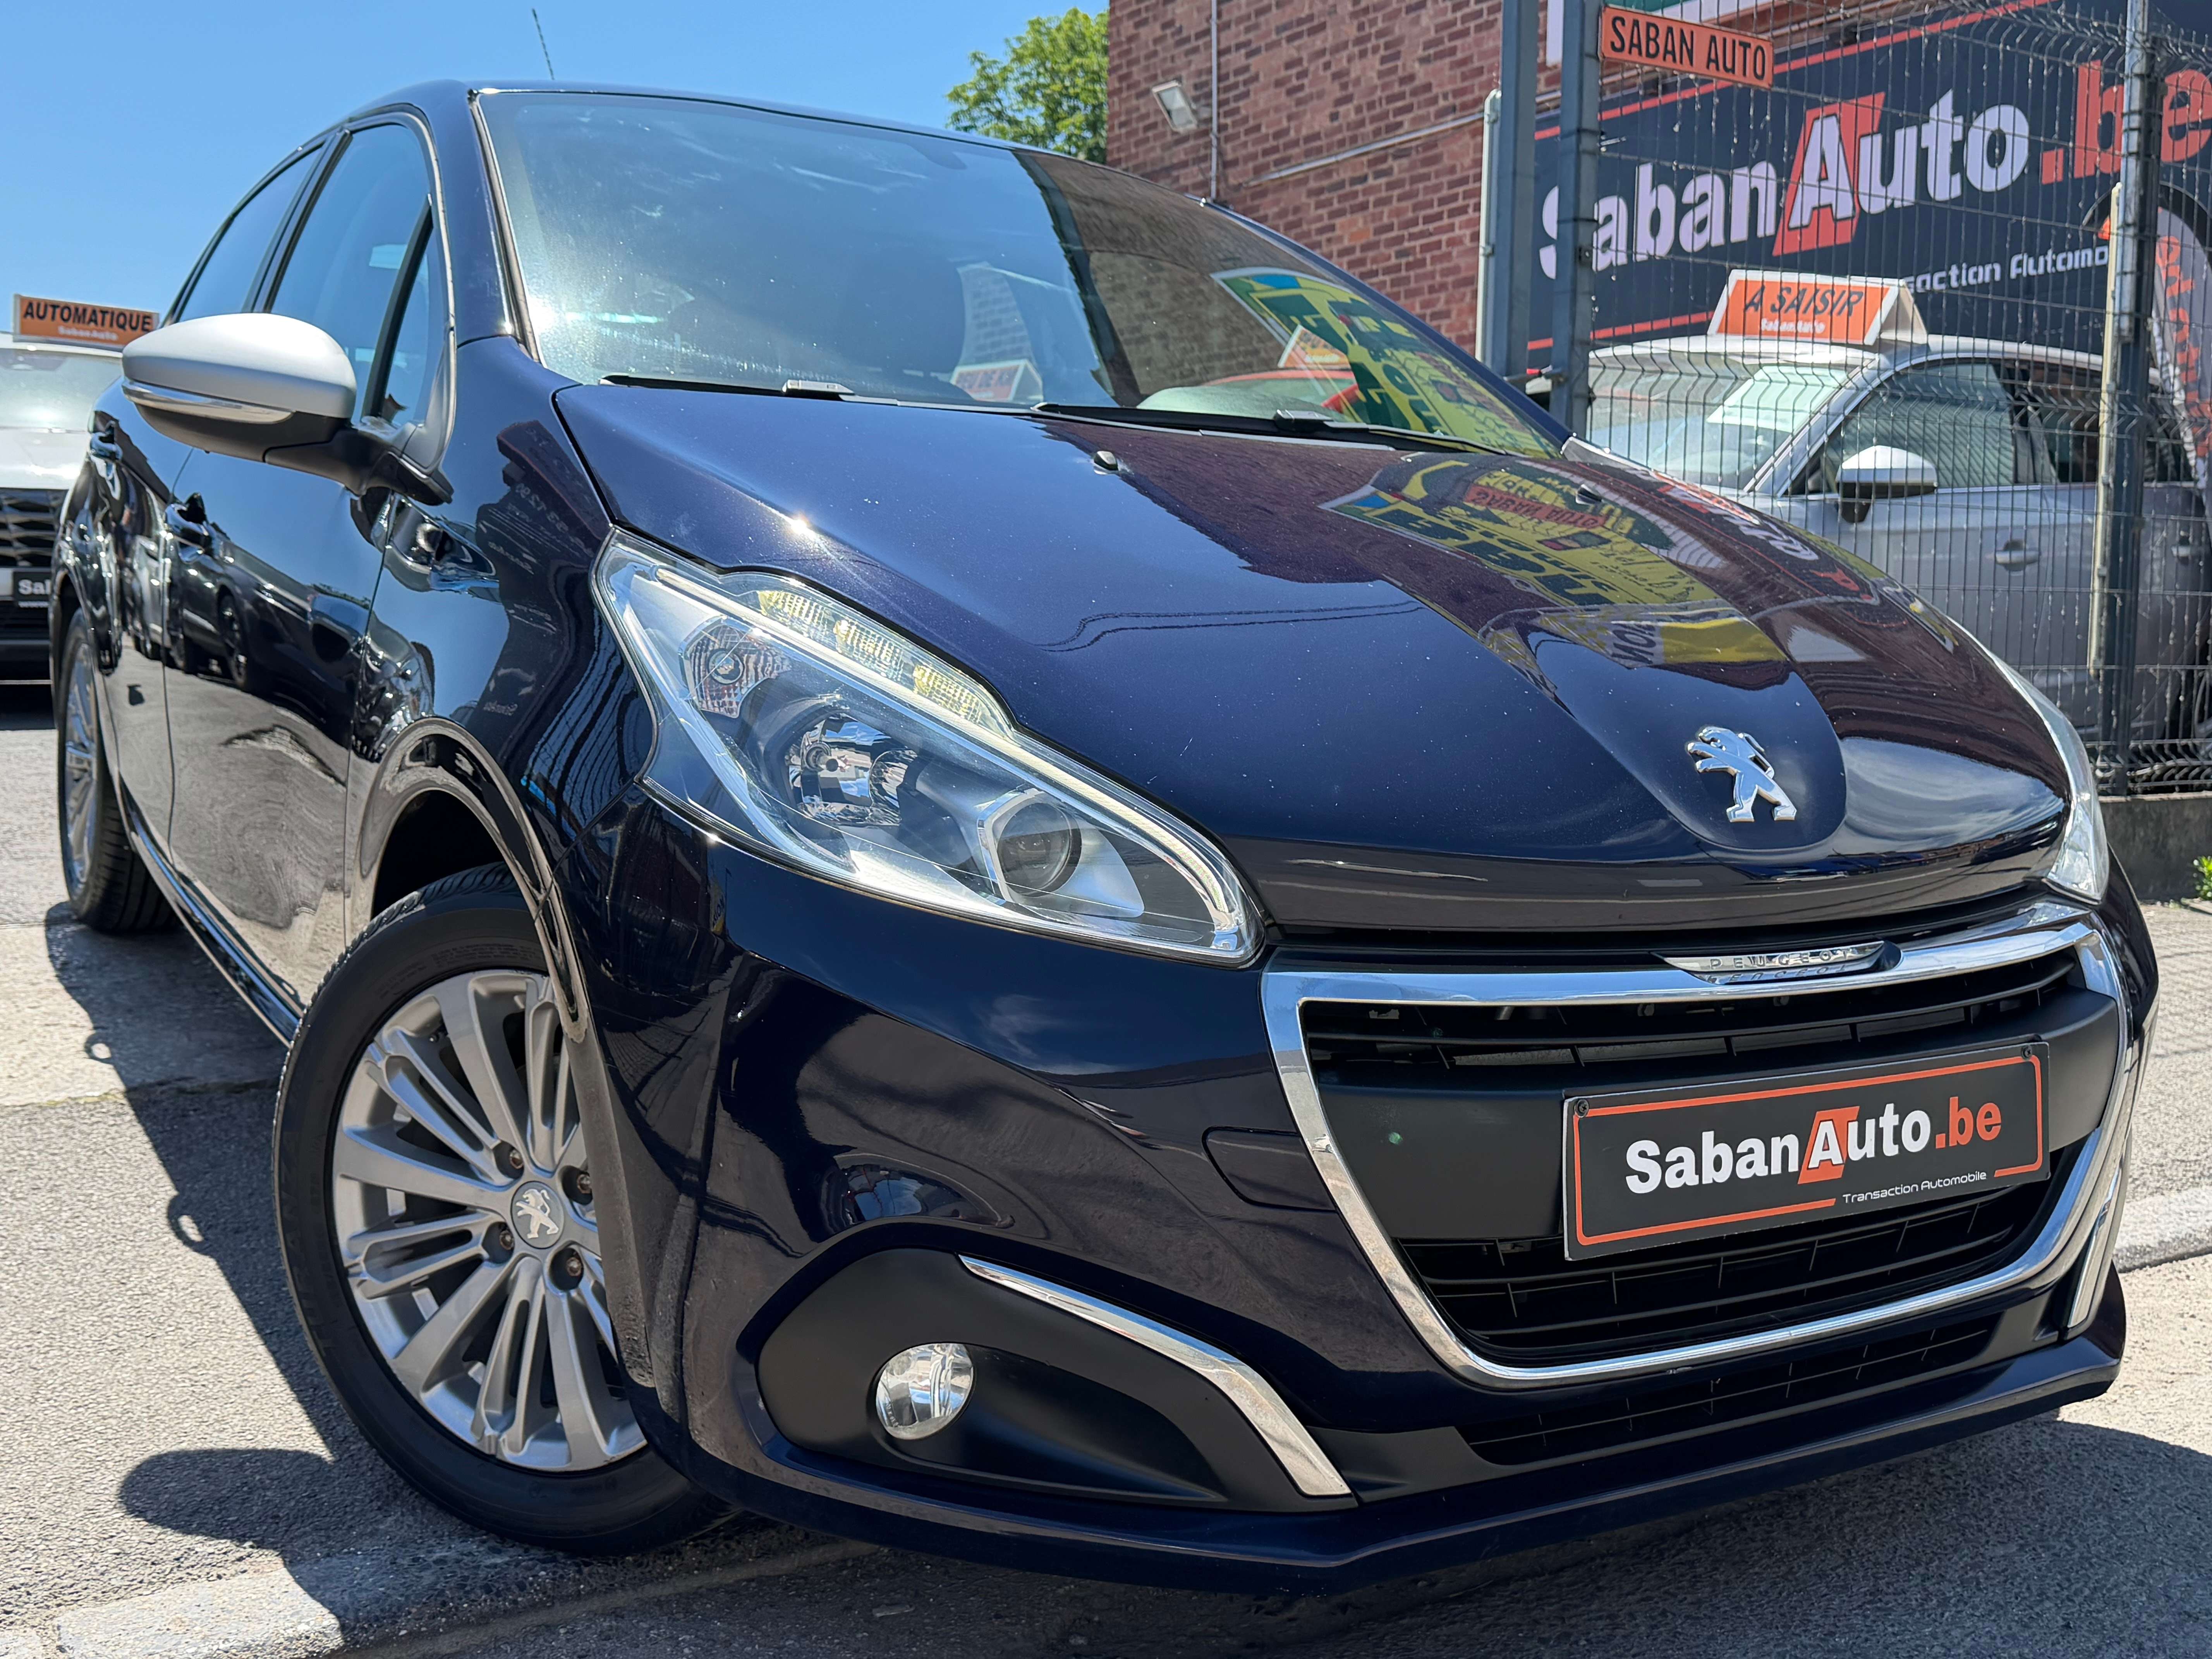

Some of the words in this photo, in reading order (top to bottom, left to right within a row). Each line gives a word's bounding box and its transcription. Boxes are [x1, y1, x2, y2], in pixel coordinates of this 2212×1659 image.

[1610, 15, 1694, 67] SABAN
[1706, 34, 1766, 81] AUTO
[2009, 245, 2109, 280] Automo
[23, 302, 153, 332] AUTOMATIQUE
[1744, 285, 1765, 313] A
[1770, 286, 1864, 317] SAISIR
[1709, 948, 1855, 970] PEUGEOT
[1626, 1096, 2002, 1194] SabanAuto.be
[1843, 1184, 1919, 1203] Transaction
[1921, 1171, 1987, 1191] Automobile
